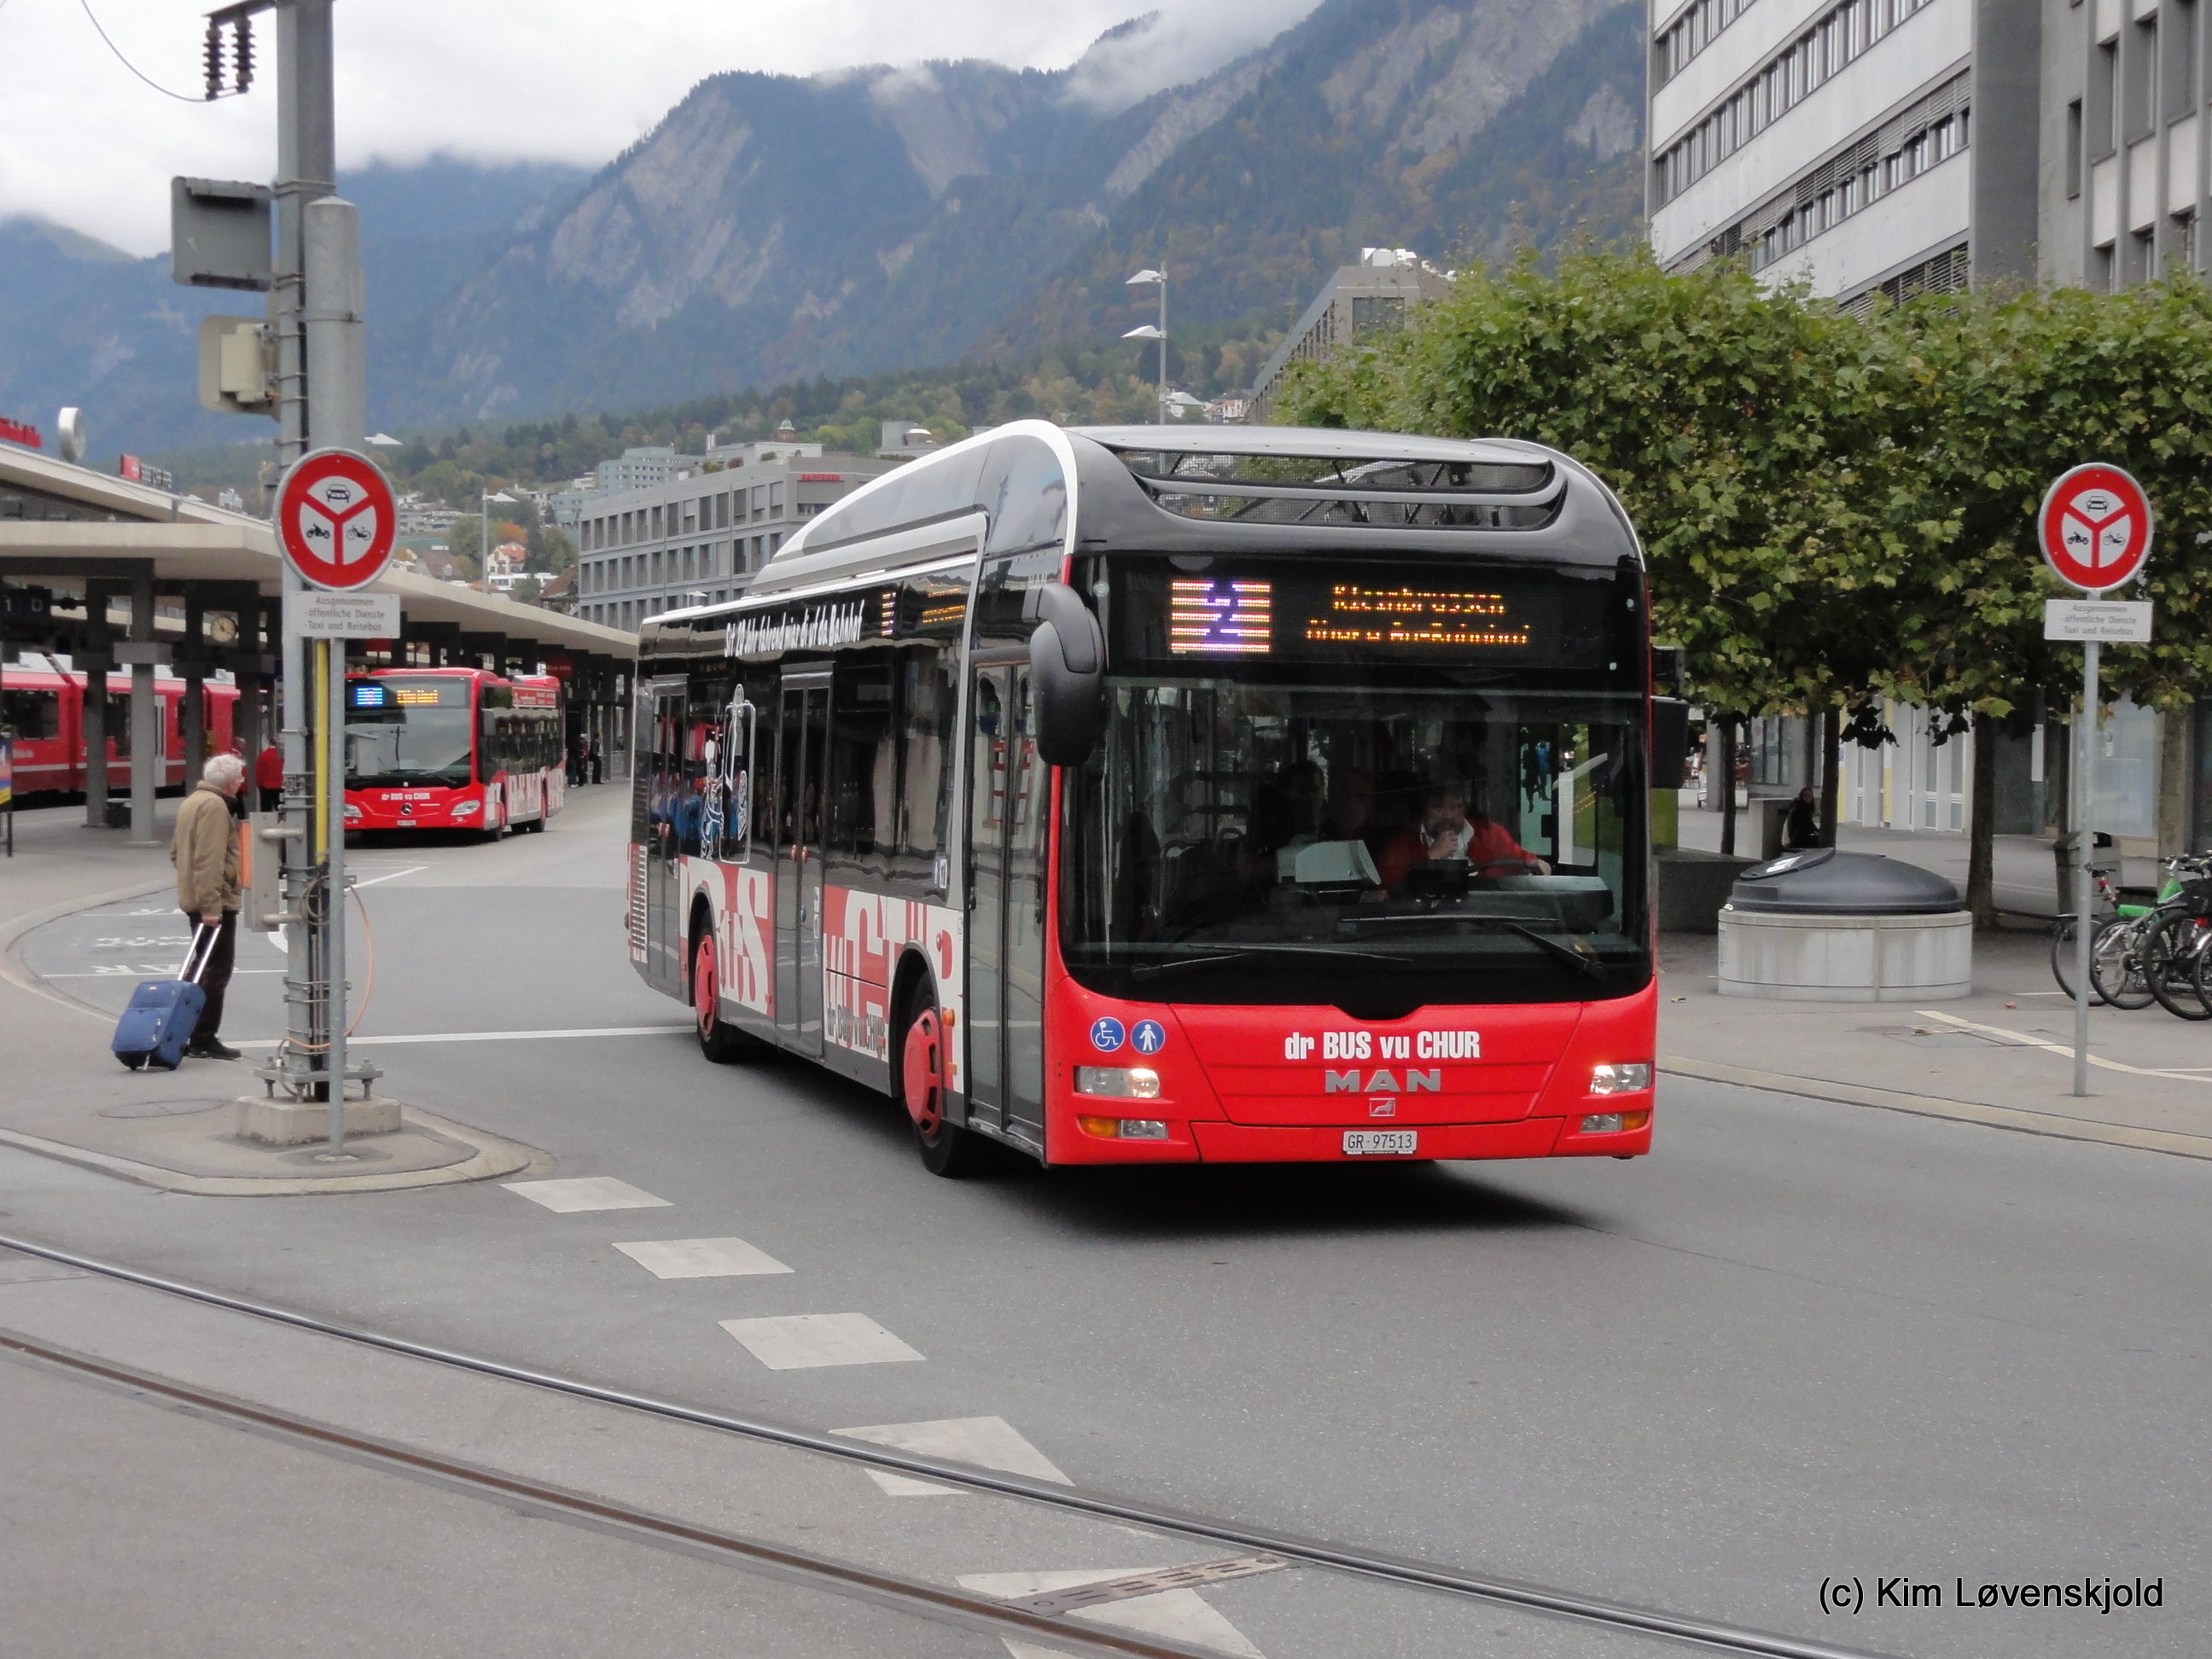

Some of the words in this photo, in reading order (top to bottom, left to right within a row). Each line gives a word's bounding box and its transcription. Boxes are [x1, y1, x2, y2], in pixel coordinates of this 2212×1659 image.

[316, 597, 375, 607] Ausgenommen
[355, 609, 385, 619] Dienste
[328, 620, 342, 630] und
[347, 621, 381, 631] Reisebus
[1284, 1032, 1314, 1059] dr
[1323, 1031, 1371, 1059] BUS
[1379, 1036, 1410, 1059] vu
[1417, 1031, 1481, 1058] CHUR
[1324, 1069, 1441, 1093] MAN
